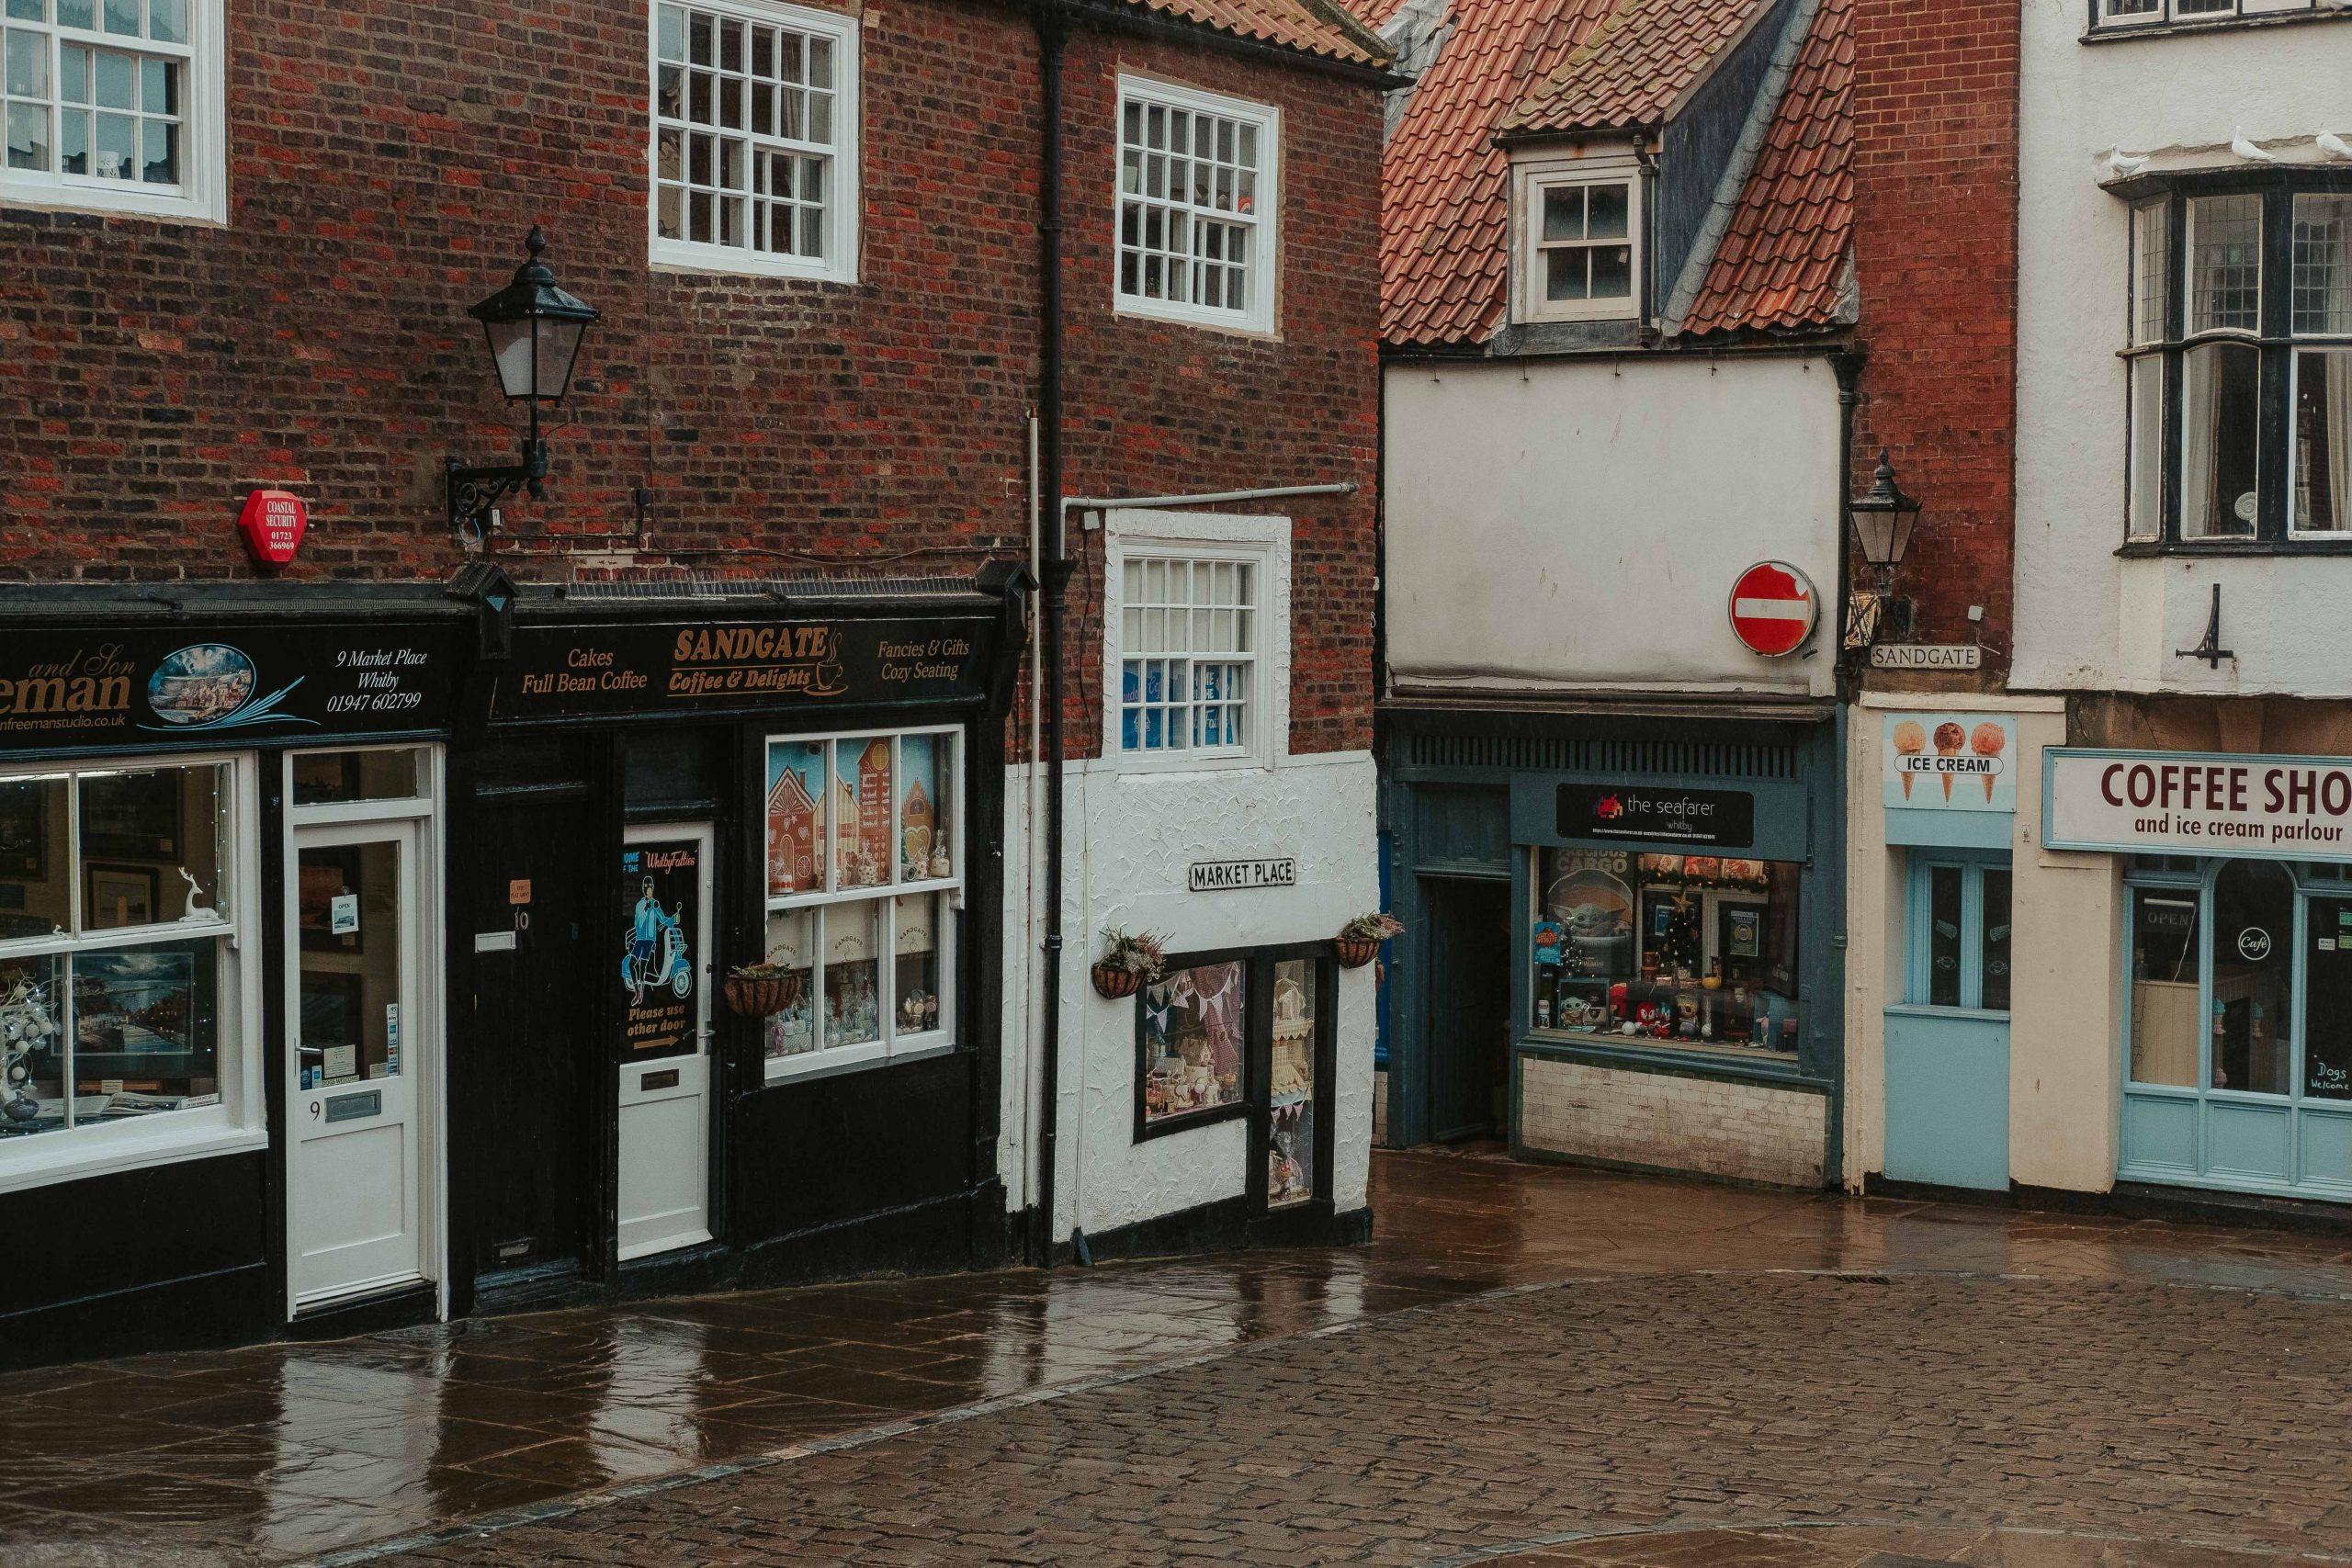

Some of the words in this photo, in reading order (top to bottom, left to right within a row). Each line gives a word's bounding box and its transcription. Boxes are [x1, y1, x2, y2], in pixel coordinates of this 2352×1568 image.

[266, 501, 296, 513] COASTAL
[266, 514, 297, 527] SECURITY
[271, 532, 292, 540] 01723
[269, 541, 295, 550] 366969
[674, 626, 829, 661] SANDGATE
[877, 640, 925, 659] Fancies
[928, 639, 941, 657] &
[942, 638, 970, 656] Gifts
[28, 649, 84, 678] and
[84, 642, 138, 676] Son
[335, 650, 347, 668] 9
[347, 649, 393, 667] Market
[393, 648, 427, 665] Place
[568, 648, 615, 668] Cakes
[1875, 649, 1975, 665] SANDGATE
[882, 662, 912, 683] Cozy
[913, 660, 959, 681] Seating
[357, 671, 399, 693] Whitby
[522, 673, 554, 694] Full
[556, 672, 596, 693] Bean
[601, 670, 648, 691] Coffee
[669, 671, 724, 694] Coffee
[726, 671, 743, 690] &
[744, 668, 811, 690] Delights
[326, 694, 370, 712] 01947
[371, 692, 422, 711] 602799
[1907, 758, 1930, 770] ICE
[1936, 759, 1990, 773] CREAM
[2100, 763, 2248, 812] COFFEE
[1628, 794, 1651, 813] the
[1657, 797, 1716, 819] seafarer
[1667, 818, 1693, 832] whitby
[2134, 813, 2169, 834] and
[2177, 816, 2201, 835] ice
[2208, 819, 2265, 839] cream
[2272, 818, 2343, 843] parlour
[628, 863, 639, 874] THE
[1194, 865, 1249, 886] MARKET
[1255, 862, 1293, 883] PLACE
[1558, 856, 1627, 874] CARGO
[514, 906, 529, 931] 10
[2147, 910, 2188, 926] OPEN
[834, 935, 865, 951] SANDGATE
[899, 926, 929, 942] SANDGATE
[766, 942, 797, 959] SANDGATE
[2241, 936, 2268, 952] Café
[628, 1007, 664, 1021] Please
[666, 1004, 686, 1016] use
[627, 1021, 658, 1037] other
[660, 1019, 686, 1032] door
[2317, 1062, 2347, 1081] Dogs
[322, 1078, 334, 1087] DOGS
[335, 1075, 358, 1085] WELCOME
[2311, 1078, 2349, 1089] Welcome
[310, 1101, 321, 1122] 9
